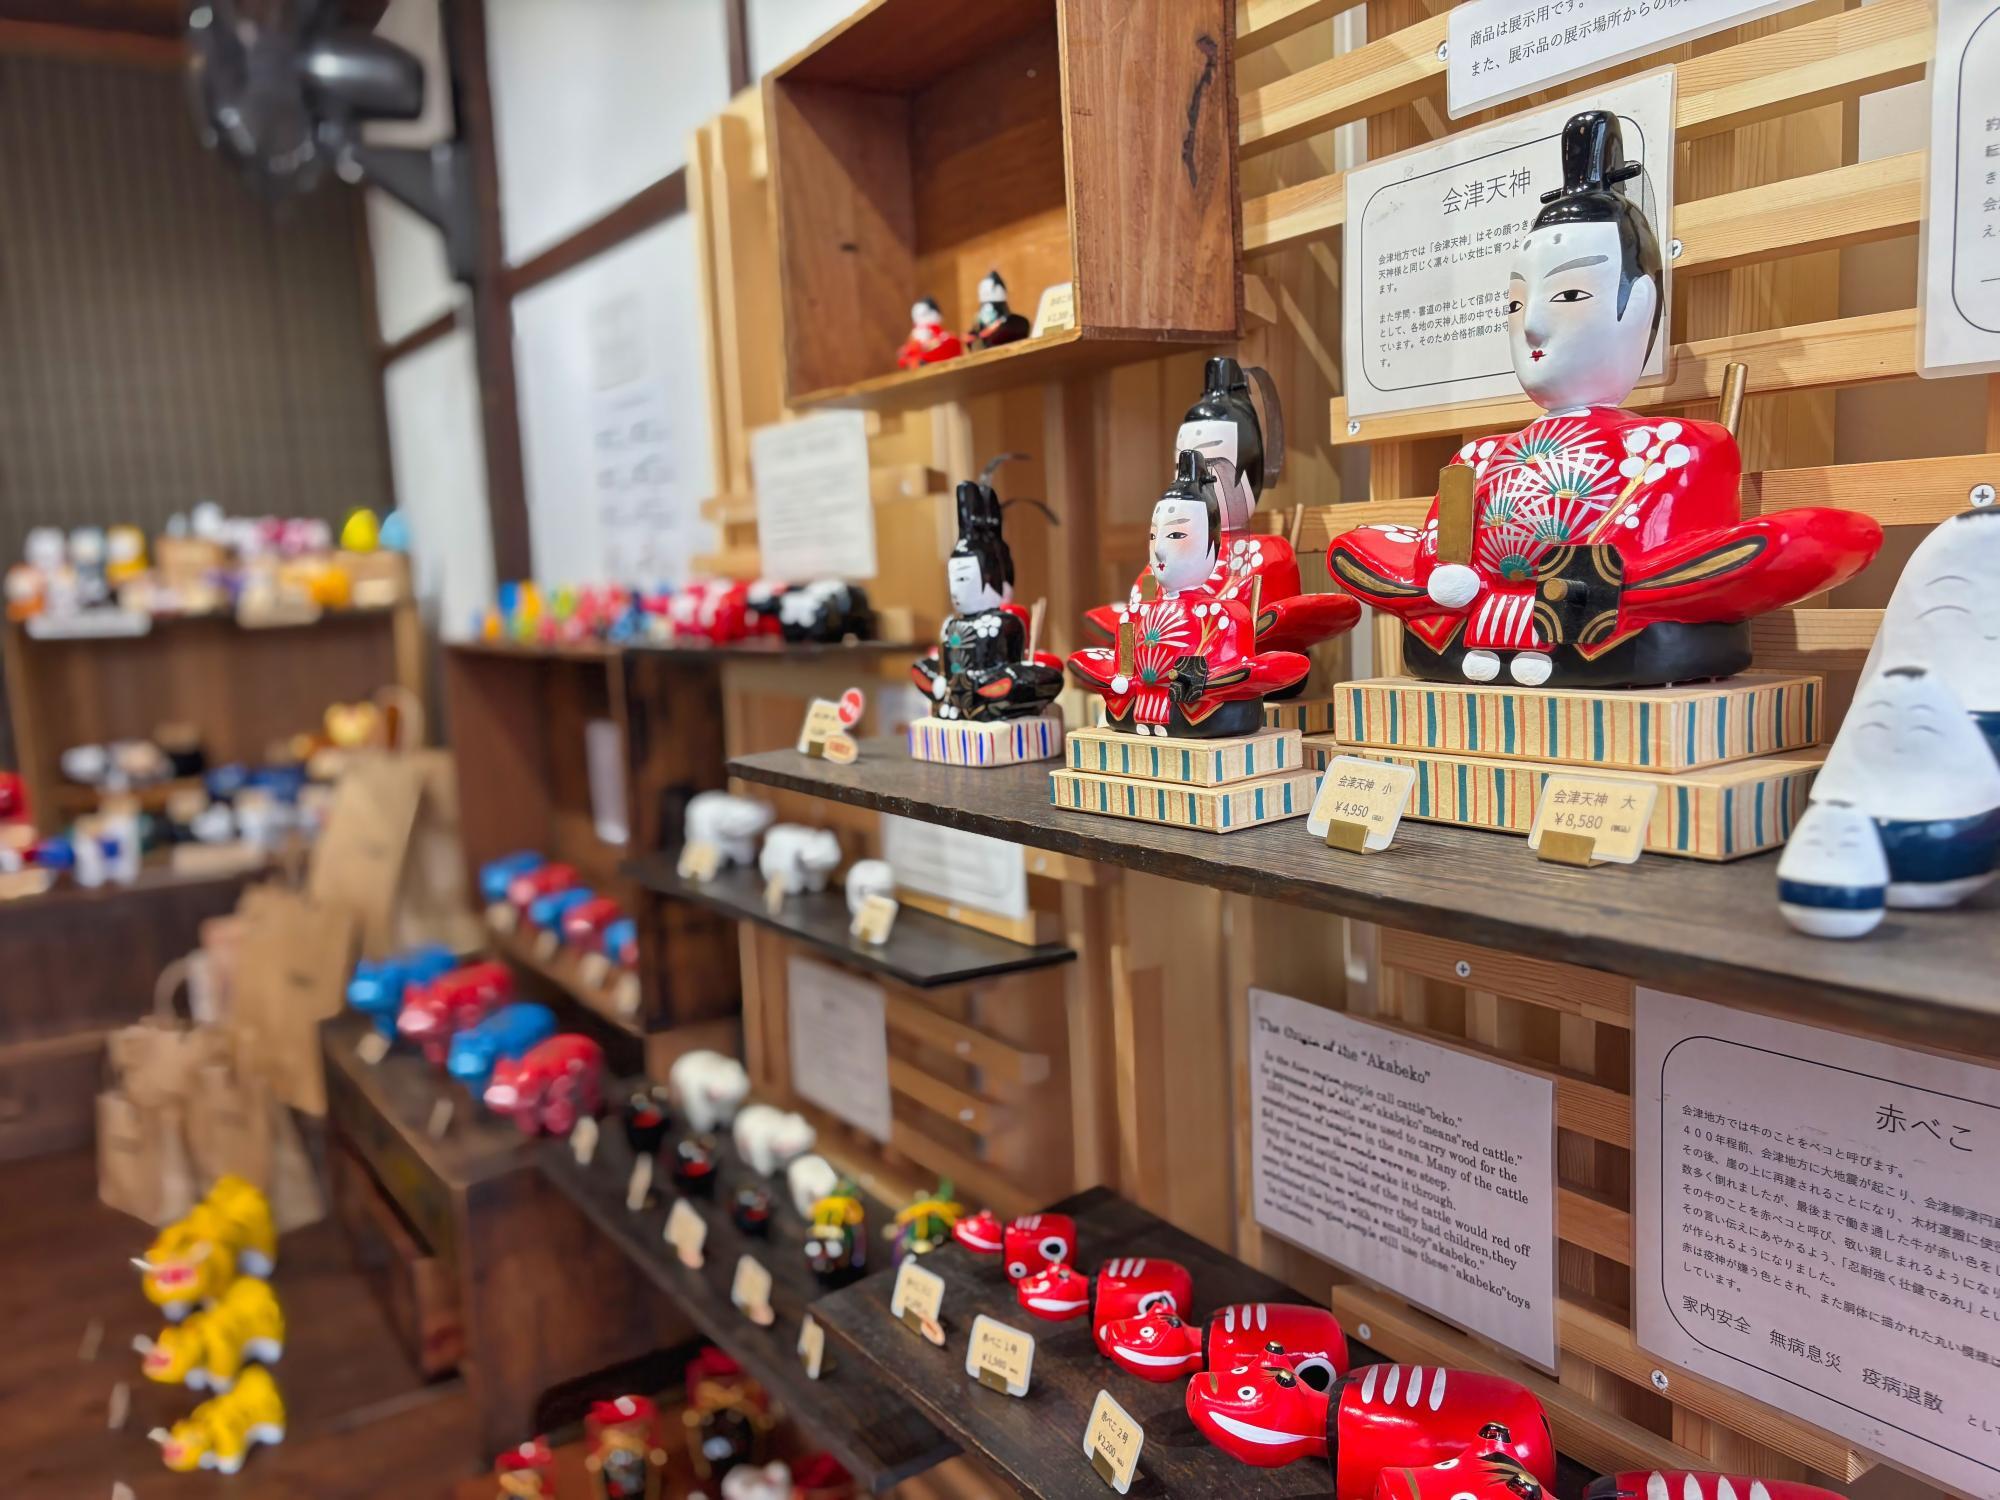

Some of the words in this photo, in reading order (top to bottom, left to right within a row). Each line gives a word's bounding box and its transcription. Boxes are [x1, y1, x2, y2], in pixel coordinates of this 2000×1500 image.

[1442, 165, 1531, 216] 会津天神
[1338, 775, 1375, 791] 会津天神
[1382, 782, 1392, 795] 小
[1553, 789, 1608, 807] 会津天神
[1620, 794, 1637, 810] 大
[1334, 801, 1369, 818] ¥4,950
[1554, 812, 1604, 830] ¥8,580
[1360, 1050, 1430, 1084] "Akabeko"
[1375, 1091, 1395, 1105] call
[1682, 1105, 1902, 1178] 会津地方では牛のことをベコと呼びます。
[1875, 1103, 1974, 1152] 赤べこ
[1404, 1131, 1417, 1145] to
[1417, 1138, 1446, 1158] carry
[1448, 1150, 1477, 1169] wood
[1479, 1158, 1496, 1175] for
[1498, 1166, 1517, 1183] the
[1400, 1177, 1410, 1192] it
[1410, 1183, 1456, 1211] through.
[1418, 1172, 1450, 1192] steep.
[1425, 1154, 1457, 1179] Many
[1459, 1170, 1472, 1183] of
[1473, 1174, 1492, 1191] the
[1495, 1185, 1529, 1204] cattle
[1401, 1196, 1419, 1211] red
[1420, 1205, 1452, 1225] cattle
[1454, 1219, 1488, 1240] would
[1491, 1234, 1511, 1250] red
[1513, 1243, 1531, 1257] off
[1420, 1217, 1441, 1238] had
[1443, 1229, 1517, 1270] children,they
[1419, 1251, 1449, 1273] these
[1682, 1222, 1835, 1286] が作られるようになりました。
[1683, 1260, 1741, 1292] しています。
[1682, 1295, 1751, 1335] 家内安全
[1769, 1328, 1842, 1373] 無病息災
[1862, 1367, 1944, 1415] 疫病退散
